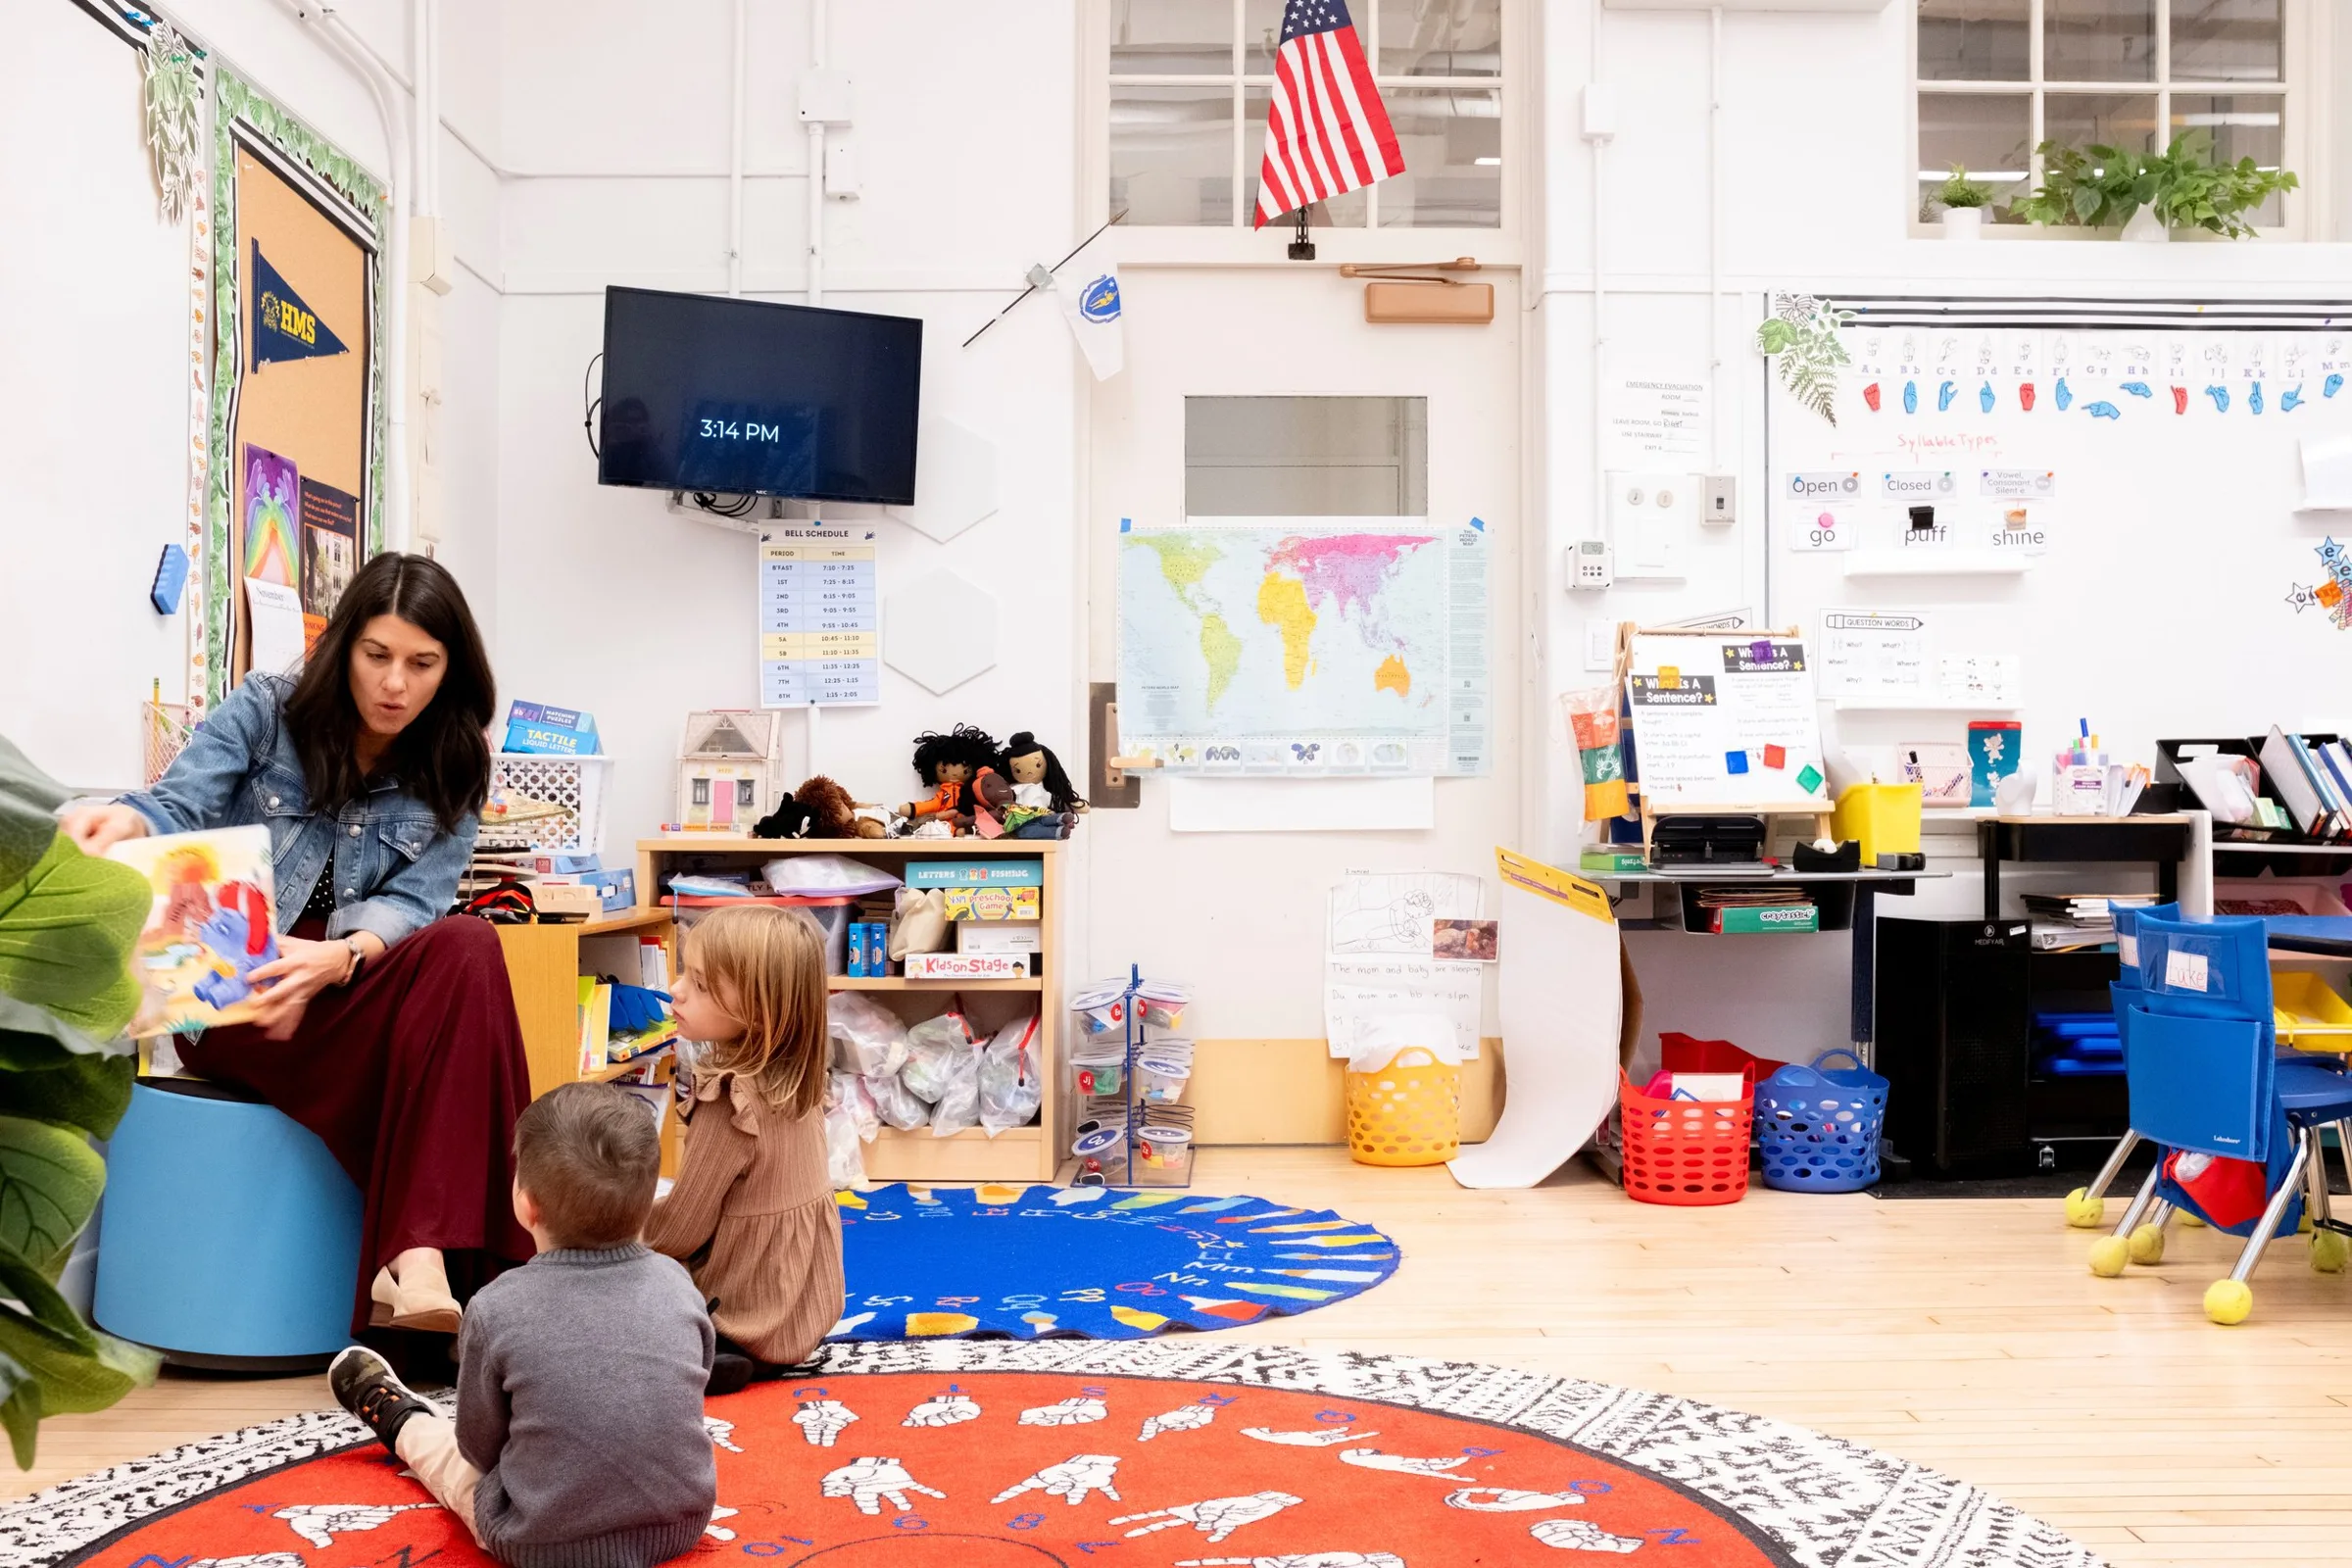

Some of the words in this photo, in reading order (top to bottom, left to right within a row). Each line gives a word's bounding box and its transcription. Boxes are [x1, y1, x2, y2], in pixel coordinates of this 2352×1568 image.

[280, 299, 316, 344] HMS
[1862, 365, 1869, 374] A
[1900, 365, 1908, 374] B
[1913, 366, 1920, 374] b
[1936, 367, 1944, 375] C
[1977, 367, 1985, 375] D
[1991, 367, 1997, 376] d
[2013, 367, 2021, 375] E
[2087, 366, 2094, 374] G
[2100, 367, 2107, 376] g
[2142, 367, 2148, 375] h
[2322, 362, 2333, 371] M
[2259, 369, 2266, 378] k
[1626, 381, 1663, 390] EMERGENCY
[1665, 383, 1703, 392] EVACUATION
[700, 418, 739, 439] 3:14
[746, 423, 779, 443] PM
[1898, 434, 1955, 451] Syllable
[1958, 434, 1997, 450] Types
[1792, 479, 1838, 496] Open
[1887, 480, 1932, 491] Closed
[1810, 530, 1836, 546] go
[1905, 526, 1947, 545] puff
[1992, 529, 2044, 545] shine
[2325, 547, 2334, 557] e
[2340, 565, 2351, 576] e
[2296, 592, 2306, 603] e
[1847, 618, 1883, 627] QUESTION
[1780, 647, 1788, 657] A
[1739, 660, 1789, 671] Sentence?
[1680, 678, 1689, 689] Is
[1692, 678, 1700, 689] A
[1646, 692, 1703, 703] Sentence?
[546, 710, 576, 720] MATCHING
[547, 715, 572, 724] PUZZLES
[527, 729, 577, 749] TACTILE
[522, 738, 548, 749] LIQUID
[549, 743, 577, 755] LETTERS
[970, 894, 1014, 903] preschool
[926, 958, 952, 973] Kids
[953, 964, 967, 973] on
[969, 958, 1009, 972] Stage
[1332, 962, 1350, 974] The
[1357, 965, 1380, 974] mom
[1385, 965, 1402, 974] and
[1408, 964, 1429, 979] baby
[1452, 964, 1481, 976] sleeping
[2169, 955, 2206, 985] Luke
[1083, 1076, 1091, 1085] Jj
[1088, 1136, 1105, 1145] Oo
[1197, 1240, 1250, 1249] Kk
[1198, 1251, 1234, 1260] Ll
[1182, 1261, 1256, 1274] Mm
[1152, 1272, 1210, 1286] Nn
[1115, 1281, 1168, 1296] Oo
[1058, 1287, 1106, 1303] Pp
[863, 1295, 914, 1307] Ss
[1568, 1479, 1612, 1495] O
[1006, 1513, 1046, 1531] 8
